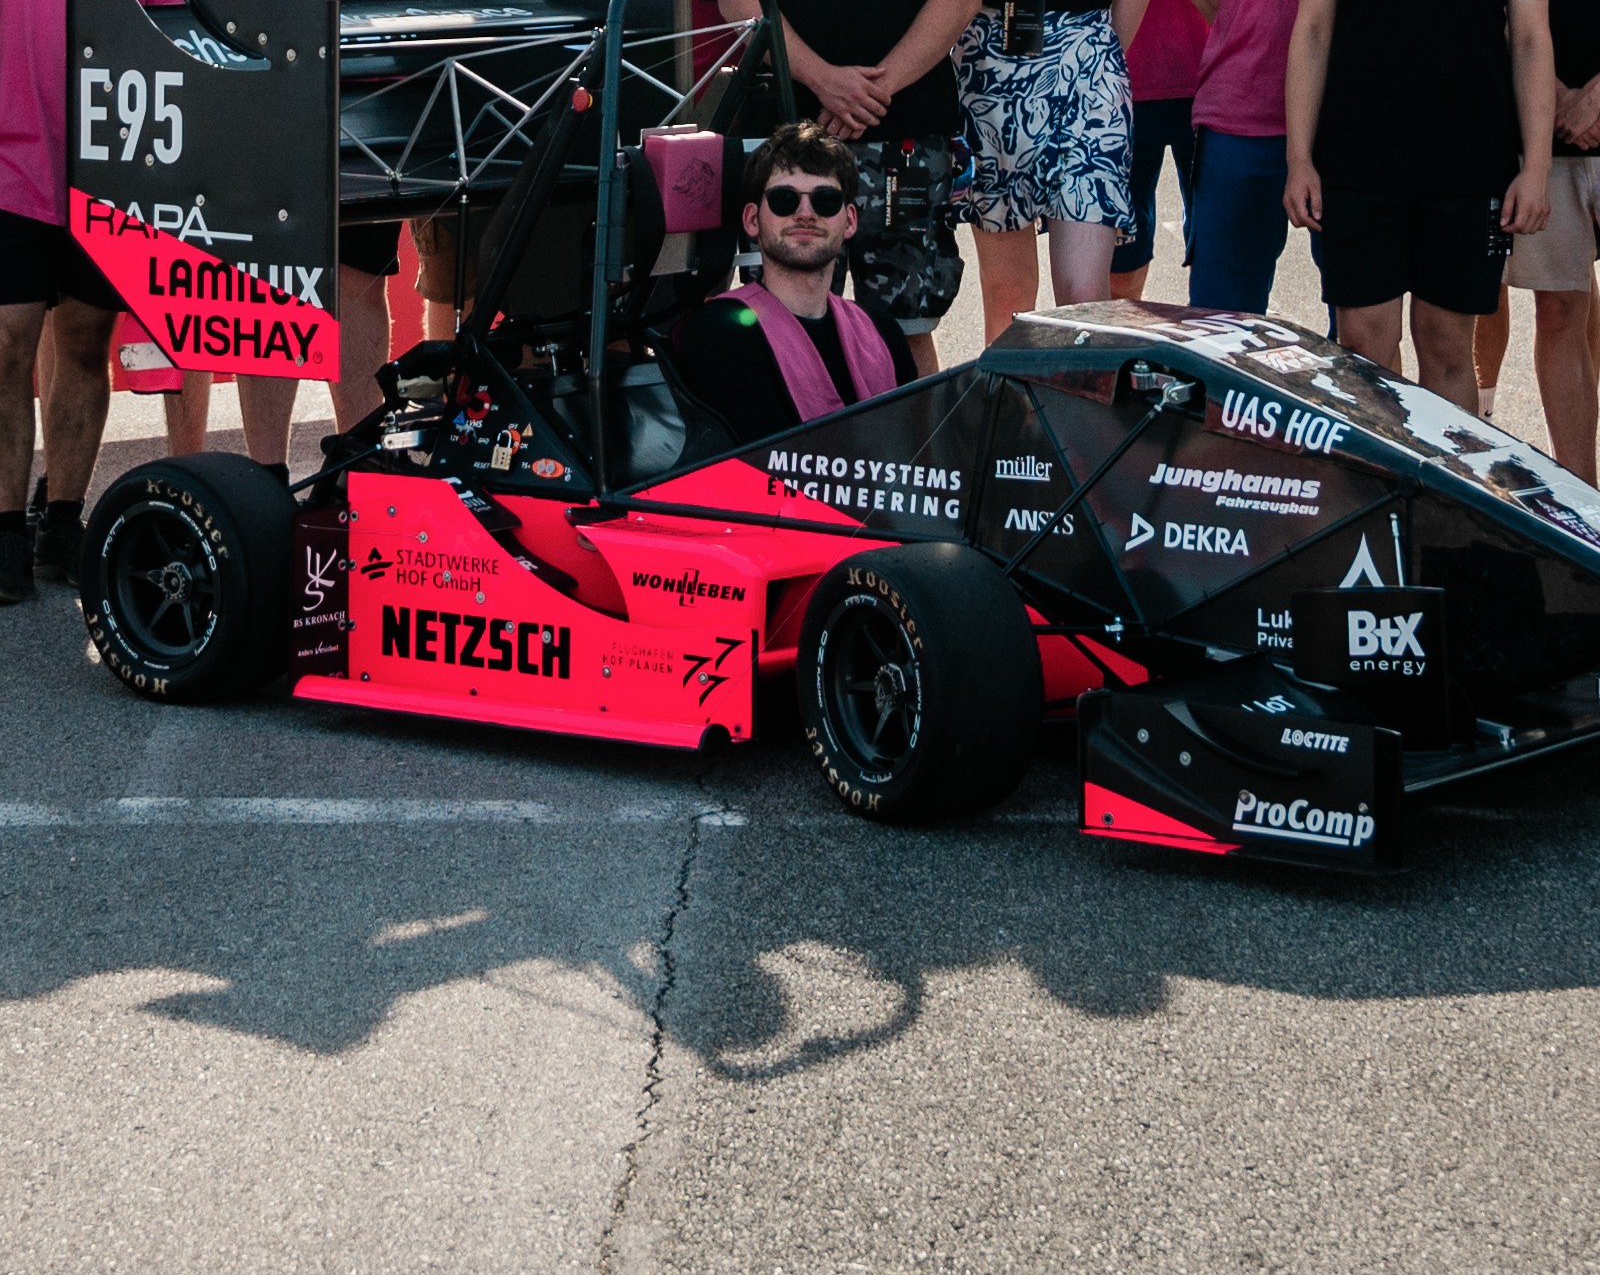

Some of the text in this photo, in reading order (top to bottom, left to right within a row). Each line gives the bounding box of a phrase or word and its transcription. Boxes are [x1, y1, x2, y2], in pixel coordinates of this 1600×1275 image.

[80, 68, 184, 165] E95
[149, 256, 323, 309] LAMILUX
[165, 313, 319, 362] VISHAY
[1221, 389, 1351, 454] UAS HOF
[768, 450, 962, 491] MICRO SYSTEMS
[995, 455, 1053, 477] müller
[1149, 463, 1321, 499] Junghanns
[767, 476, 960, 519] ENGINEERING
[1215, 495, 1320, 516] Fahrzeugbau
[1163, 522, 1249, 556] DEKRA
[396, 549, 500, 575] STADTWERKE
[396, 570, 482, 592] HOF GmbH
[305, 610, 346, 626] KRONACH
[1347, 610, 1426, 657] BtX
[381, 604, 571, 680] NETZSCH
[612, 642, 674, 661] FLUGHAFEN
[1350, 658, 1426, 676] energy
[1280, 727, 1349, 753] LOCTITE
[1234, 791, 1375, 847] ProComp
